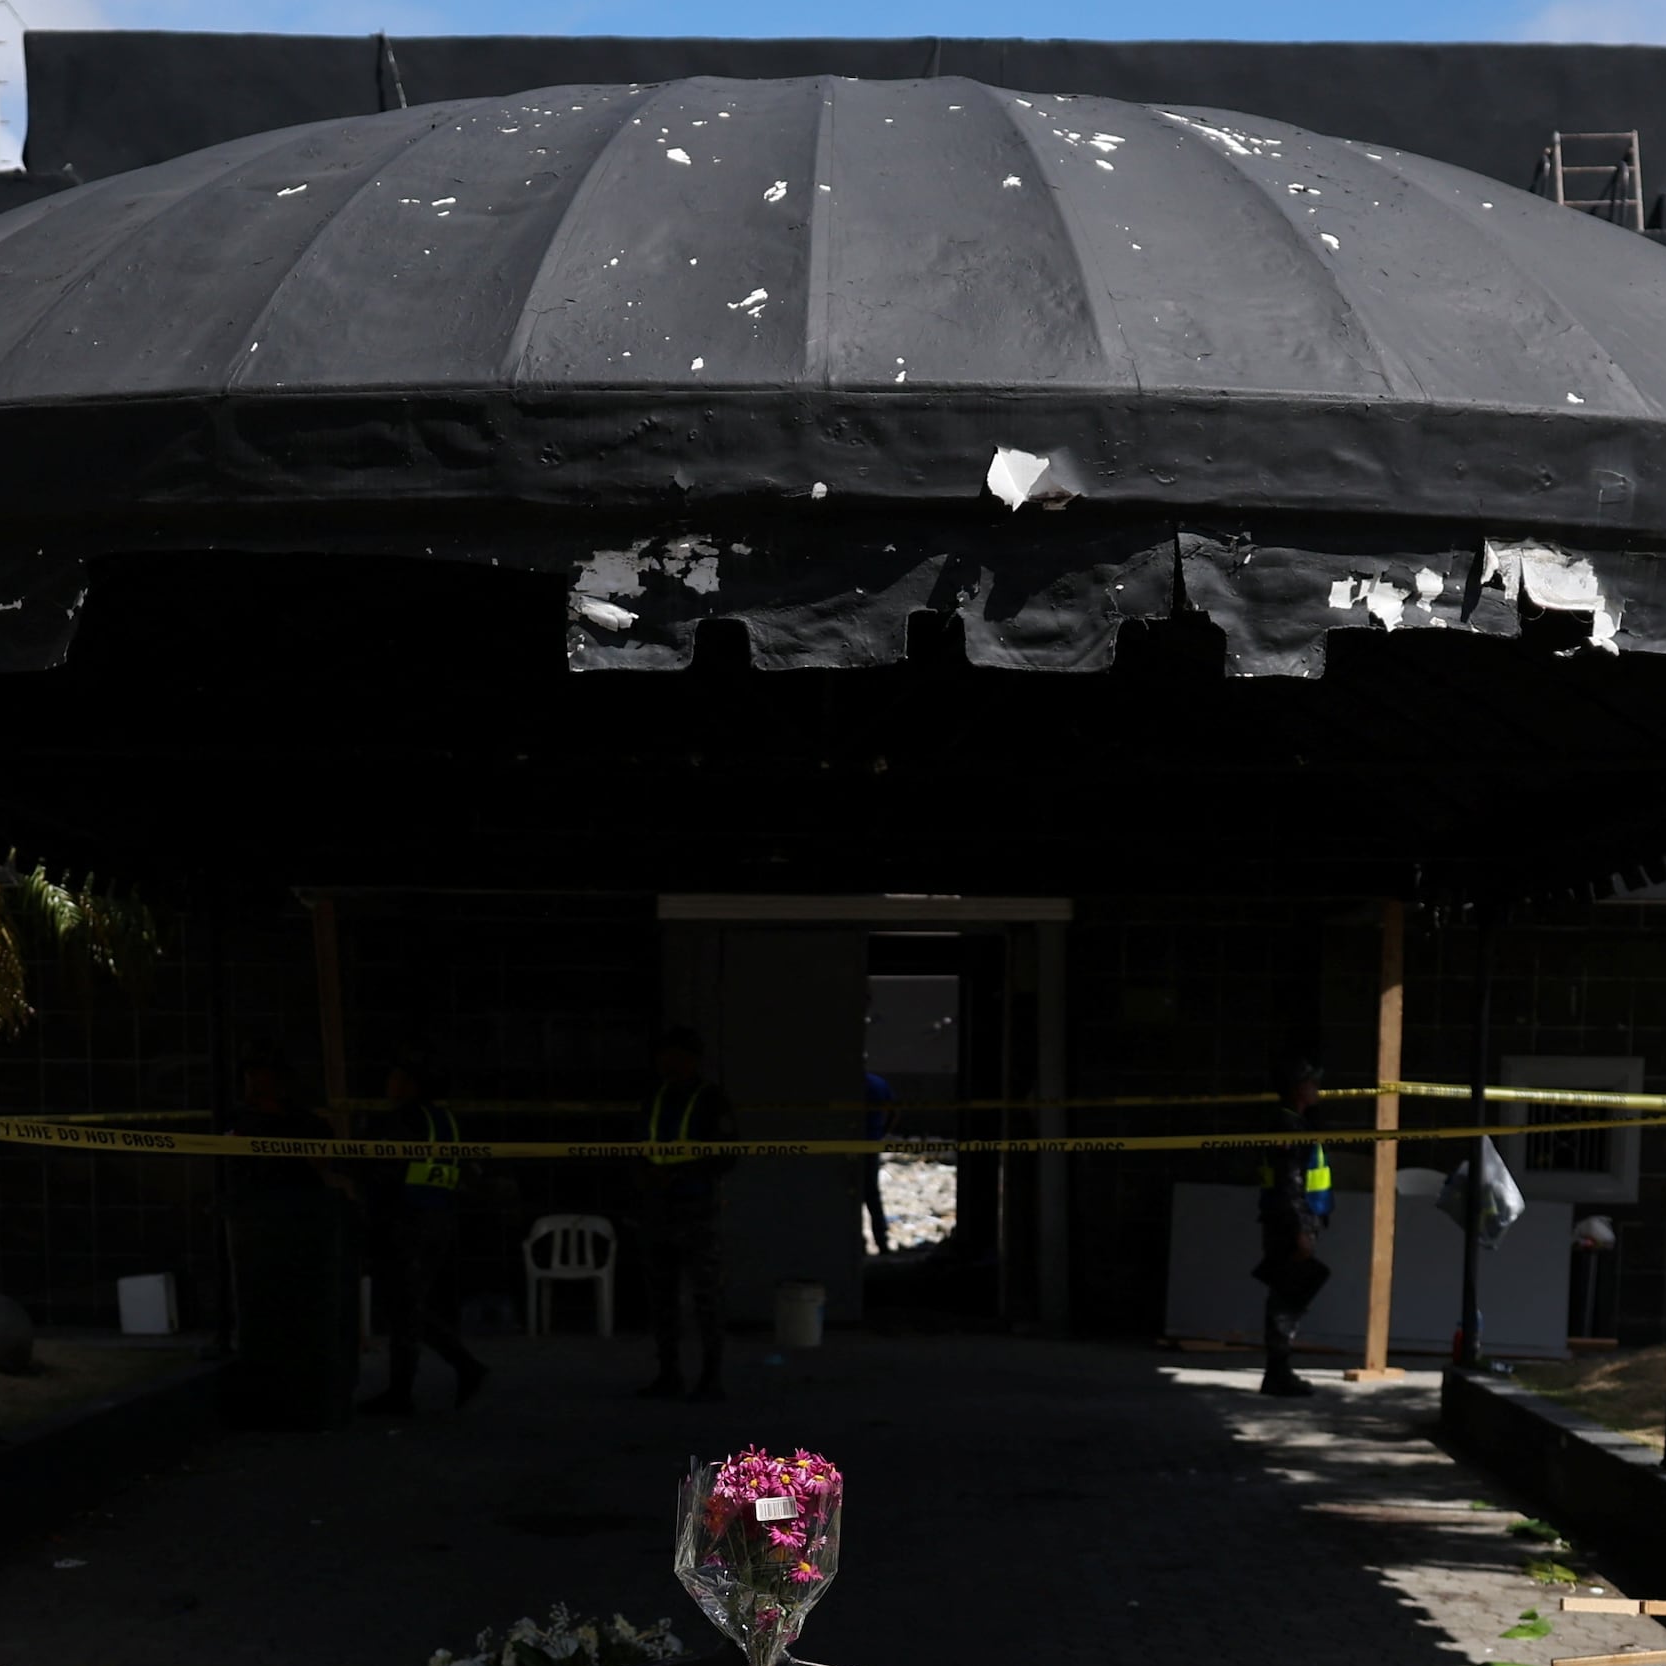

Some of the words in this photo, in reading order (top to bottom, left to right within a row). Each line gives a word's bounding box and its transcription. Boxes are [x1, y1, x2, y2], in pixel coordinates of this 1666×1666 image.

[15, 1123, 53, 1141] LINE
[57, 1127, 80, 1142] DO
[85, 1130, 117, 1146] NOT
[122, 1132, 176, 1150] CROSS
[250, 1139, 327, 1155] SECURITY
[332, 1142, 369, 1157] LINE
[374, 1144, 397, 1158] DO
[402, 1144, 434, 1158] NOT
[439, 1145, 493, 1159] CROSS
[568, 1145, 644, 1160] SECURITY
[649, 1145, 685, 1158] LINE
[691, 1145, 712, 1158] DO
[718, 1145, 751, 1158] NOT
[756, 1144, 809, 1158] CROSS
[884, 1142, 960, 1153] SECURITY
